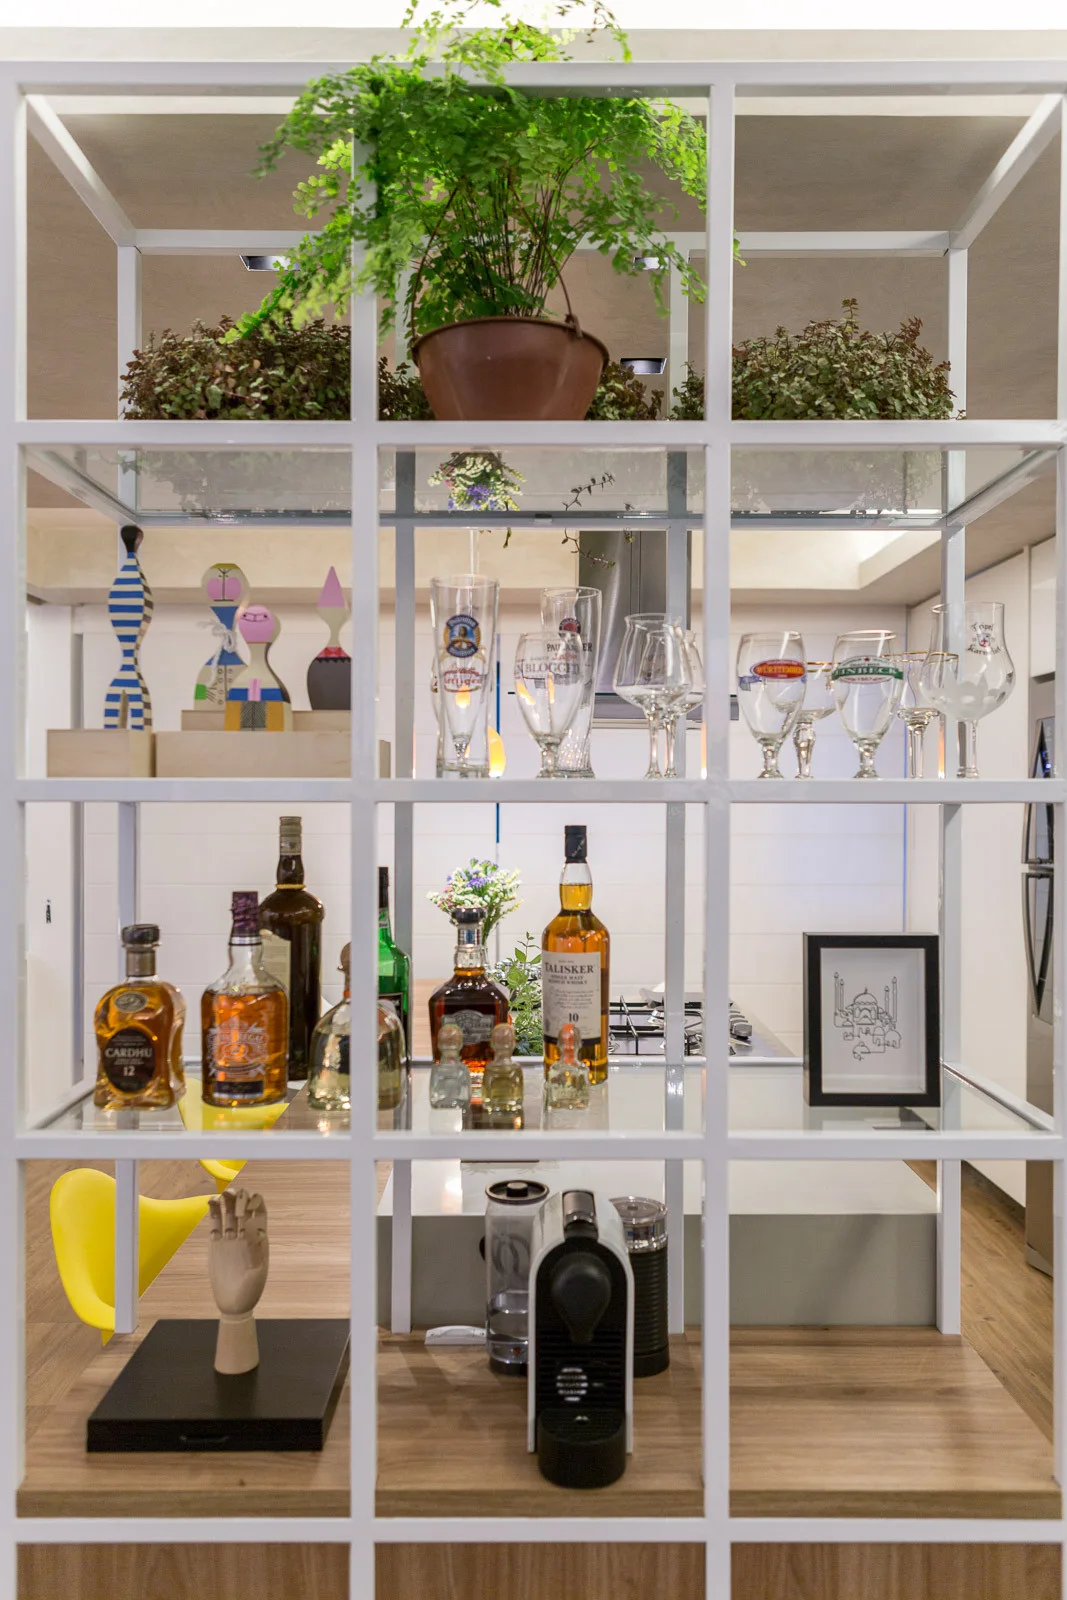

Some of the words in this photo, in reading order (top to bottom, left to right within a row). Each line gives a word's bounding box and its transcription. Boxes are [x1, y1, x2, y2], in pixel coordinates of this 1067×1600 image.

[546, 642, 593, 652] PAUANER
[967, 644, 1001, 656] Karmliet
[544, 962, 594, 974] TALISKER
[568, 1013, 579, 1022] 10
[104, 1047, 153, 1058] CARDHU
[123, 1065, 136, 1077] 12
